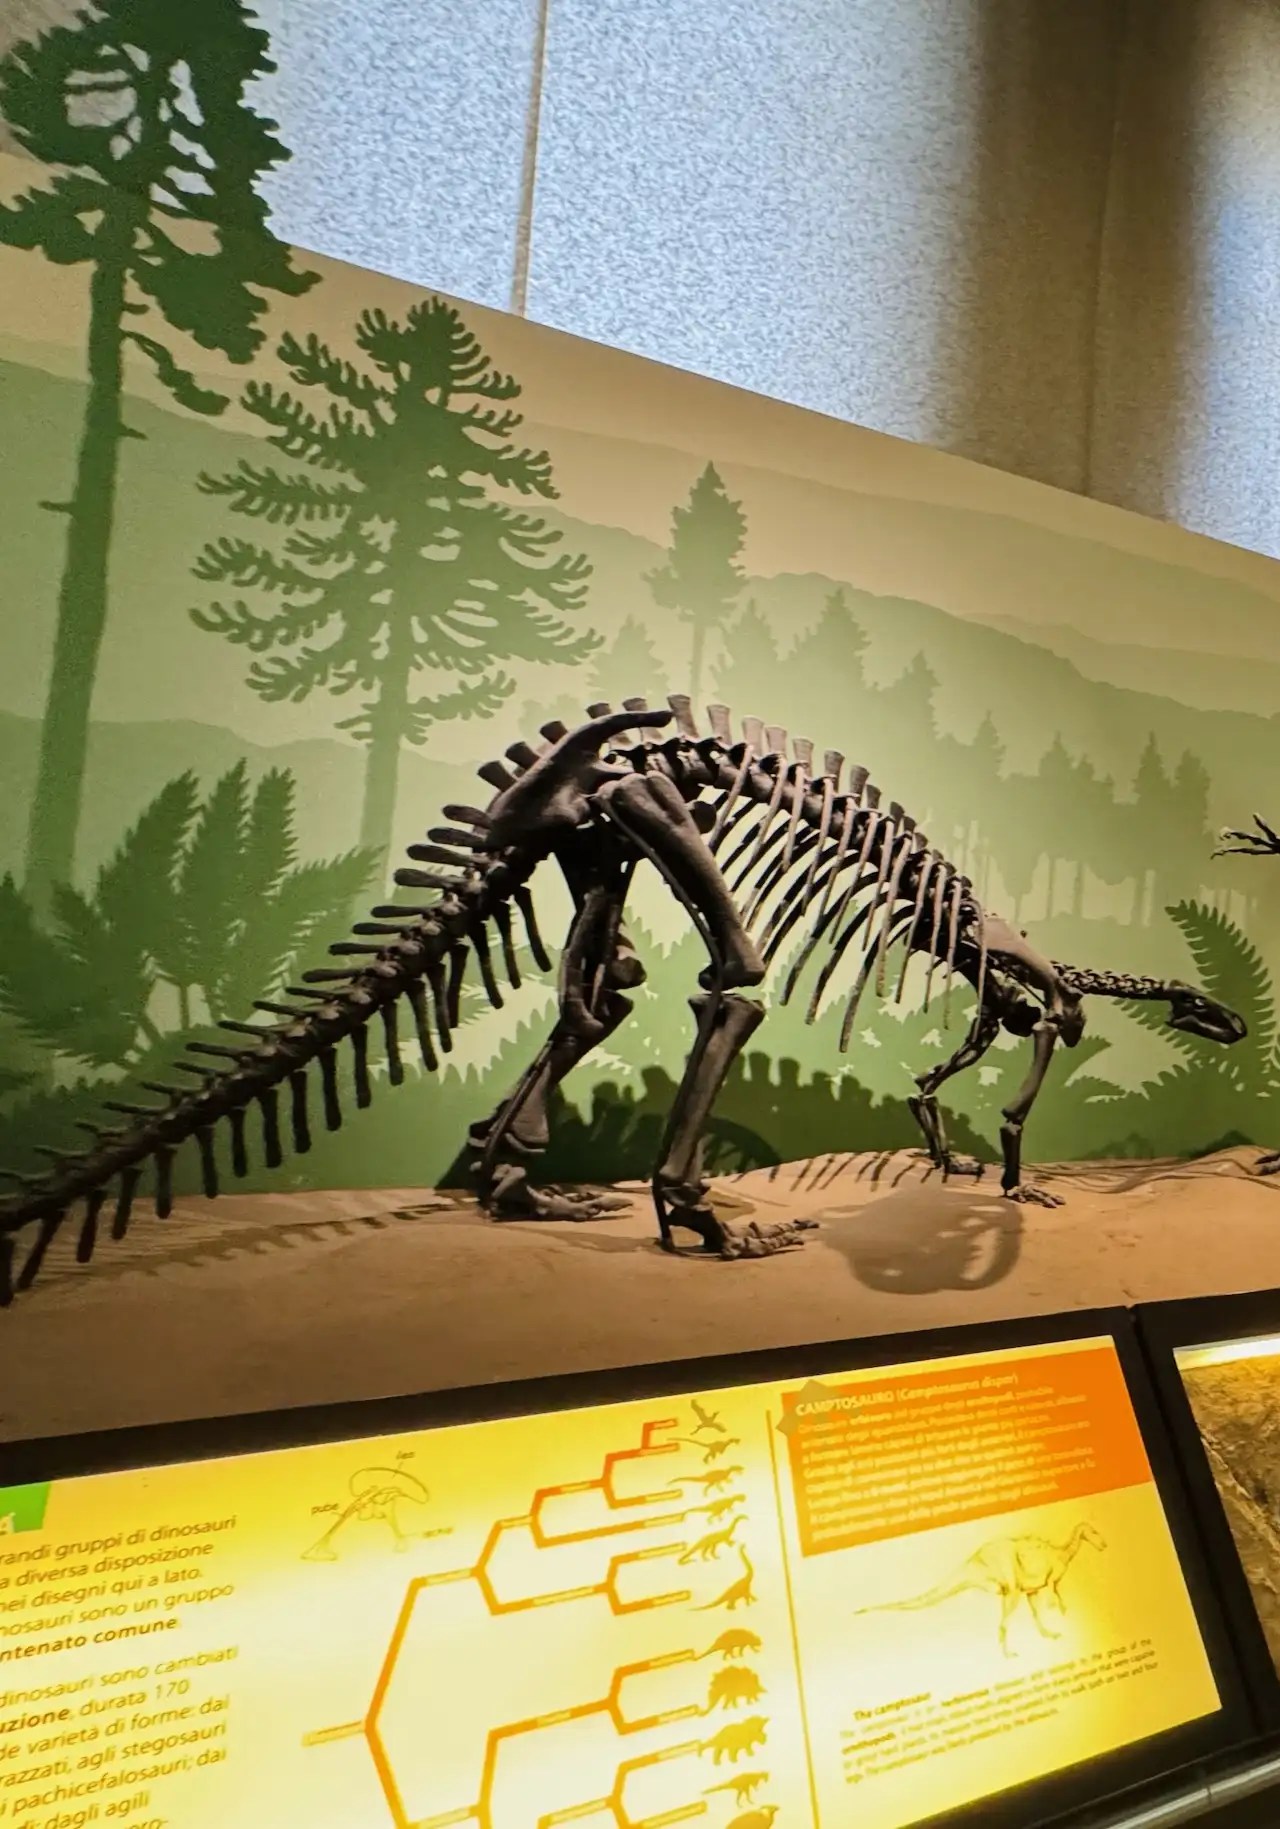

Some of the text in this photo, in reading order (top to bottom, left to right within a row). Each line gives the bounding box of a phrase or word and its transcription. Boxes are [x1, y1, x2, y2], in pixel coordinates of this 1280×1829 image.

[55, 1533, 122, 1561] gruppi
[127, 1529, 147, 1546] di
[150, 1515, 237, 1542] dinosauri
[15, 1564, 88, 1587] diversa
[94, 1543, 214, 1572] disposizione
[31, 1581, 107, 1605] disegni
[111, 1574, 143, 1595] qui
[147, 1575, 158, 1586] a
[78, 1603, 128, 1624] sono
[133, 1598, 158, 1613] un
[163, 1583, 235, 1611] gruppo
[100, 1666, 149, 1687] sono
[154, 1646, 238, 1675] cambiati
[79, 1691, 147, 1716] durata
[155, 1679, 190, 1700] 170
[105, 1718, 125, 1737] di
[199, 1694, 230, 1715] dai
[77, 1746, 116, 1771] agli
[121, 1722, 226, 1759] stegosauri
[196, 1747, 226, 1767] dai
[45, 1804, 100, 1829] dagli
[105, 1790, 150, 1818] agili
